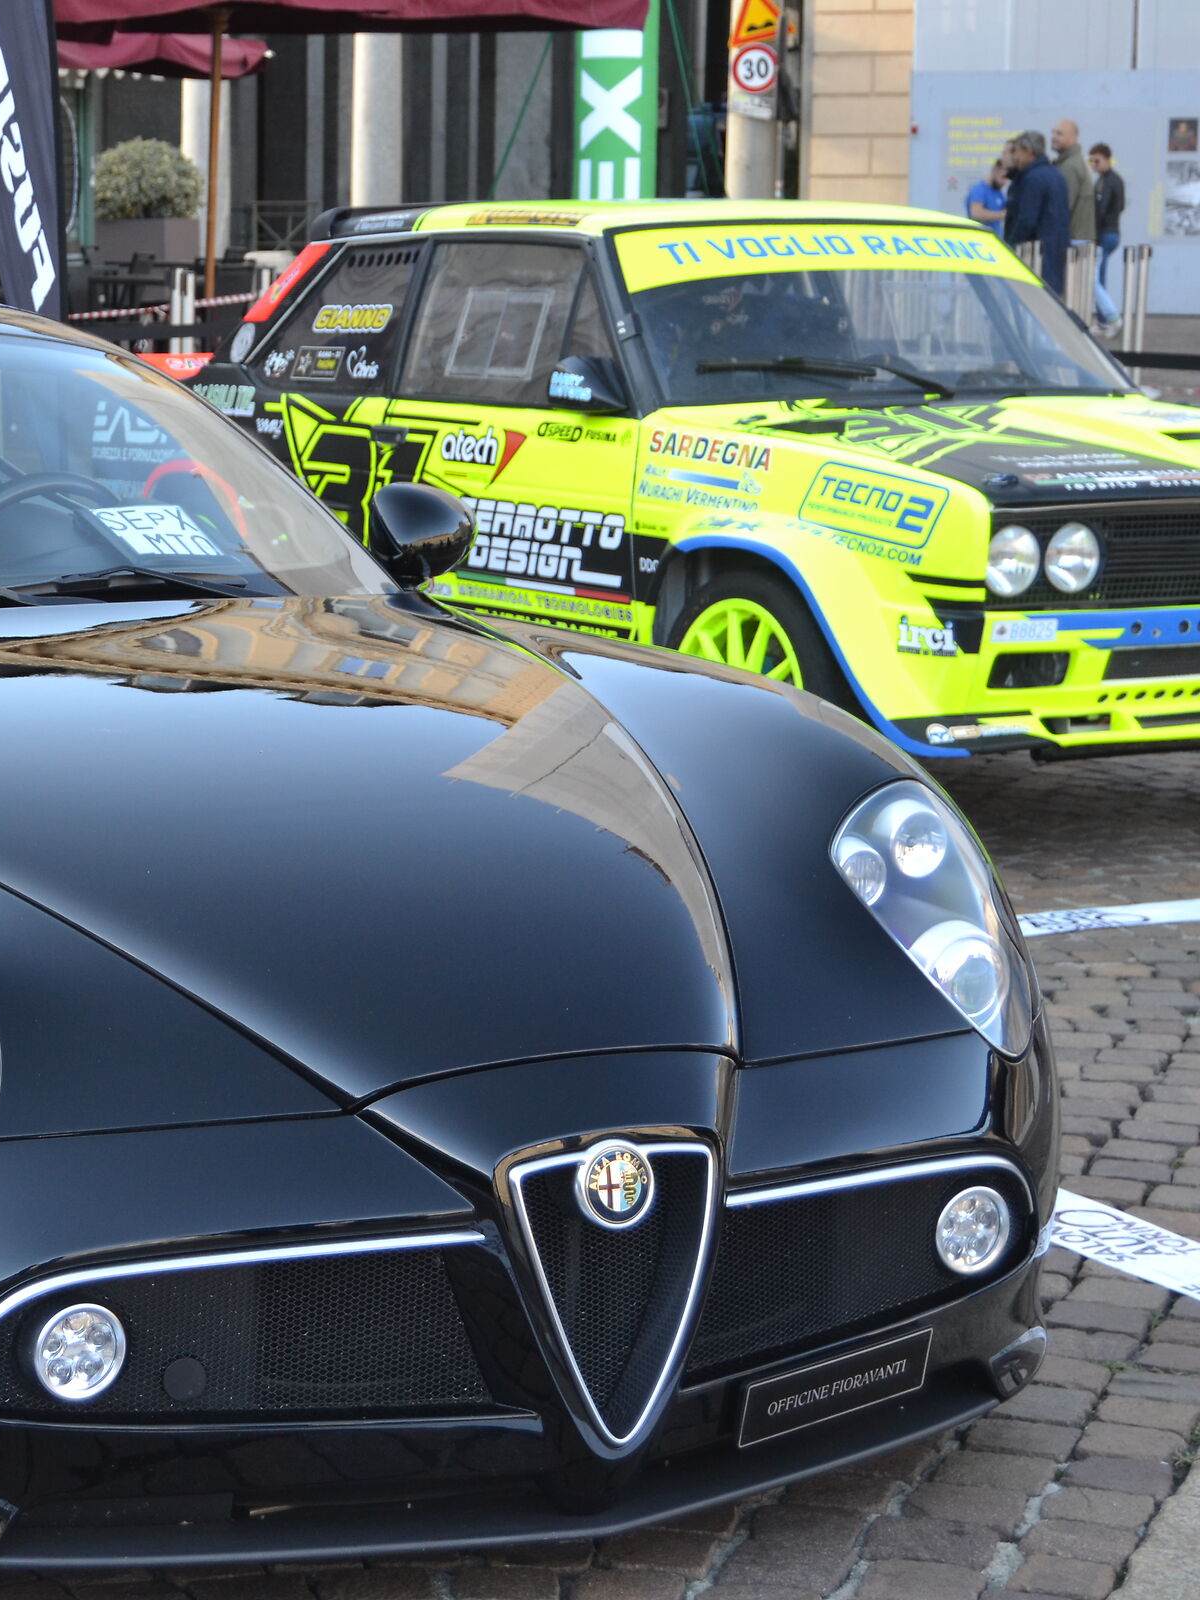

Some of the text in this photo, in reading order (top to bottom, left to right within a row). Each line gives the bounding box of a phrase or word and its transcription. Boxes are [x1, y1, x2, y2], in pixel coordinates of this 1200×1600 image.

[742, 57, 768, 81] 30
[658, 235, 997, 266] TI VOGLIO RACING
[441, 426, 499, 466] atech
[650, 430, 771, 471] SARDEGNA
[467, 534, 622, 588] DESIGN
[457, 583, 532, 606] MECHANICAL
[535, 594, 634, 622] TECHNOLOGIES
[589, 1151, 648, 1191] ALFA ROMEO
[1051, 1225, 1137, 1263] SALON
[1055, 1209, 1163, 1256] AUTO
[767, 1359, 908, 1416] OFFICINE FIORAVANTI
